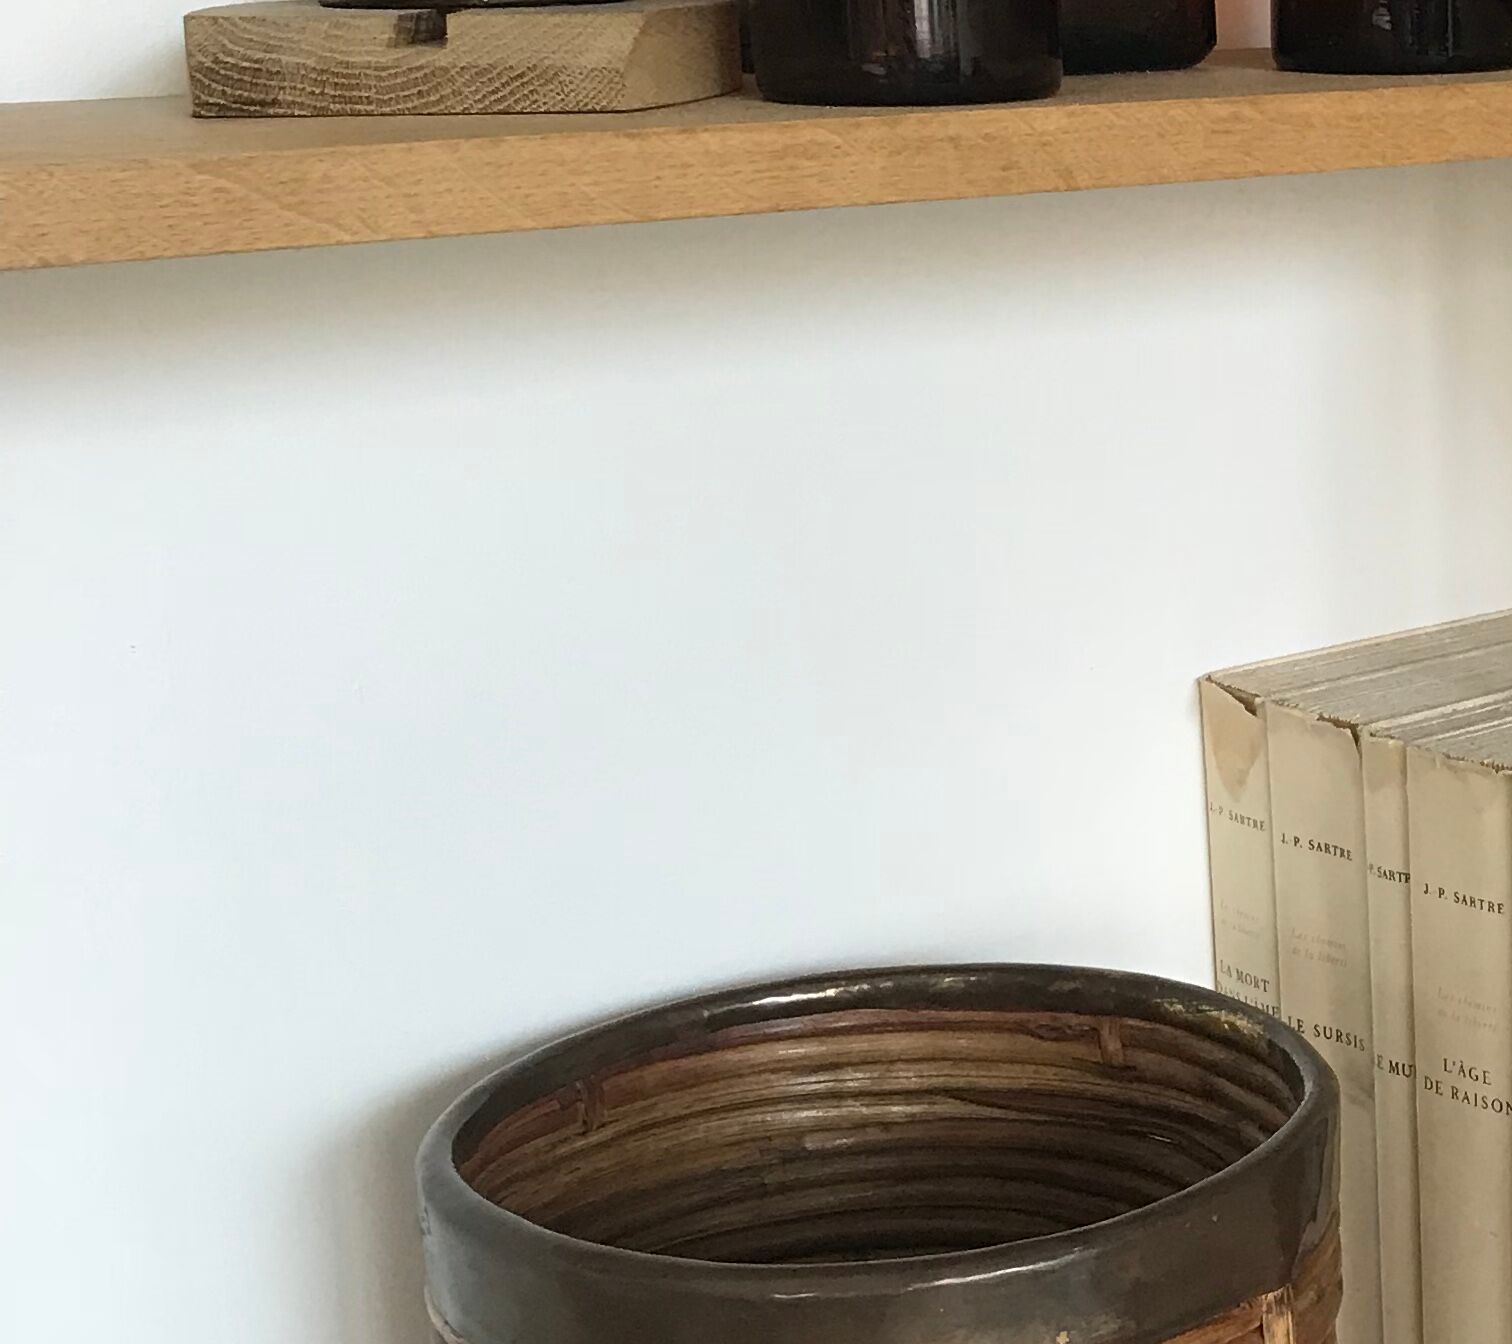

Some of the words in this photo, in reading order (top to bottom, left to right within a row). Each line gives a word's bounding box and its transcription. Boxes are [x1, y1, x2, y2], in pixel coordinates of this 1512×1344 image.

[1228, 808, 1266, 832] SARTRE
[1308, 839, 1353, 862] SARTRE
[1453, 891, 1505, 915] SARTRE
[1219, 959, 1233, 978] LA
[1235, 968, 1271, 993] MORT
[1313, 1023, 1367, 1053] SURSIS
[1424, 1075, 1443, 1096] DE
